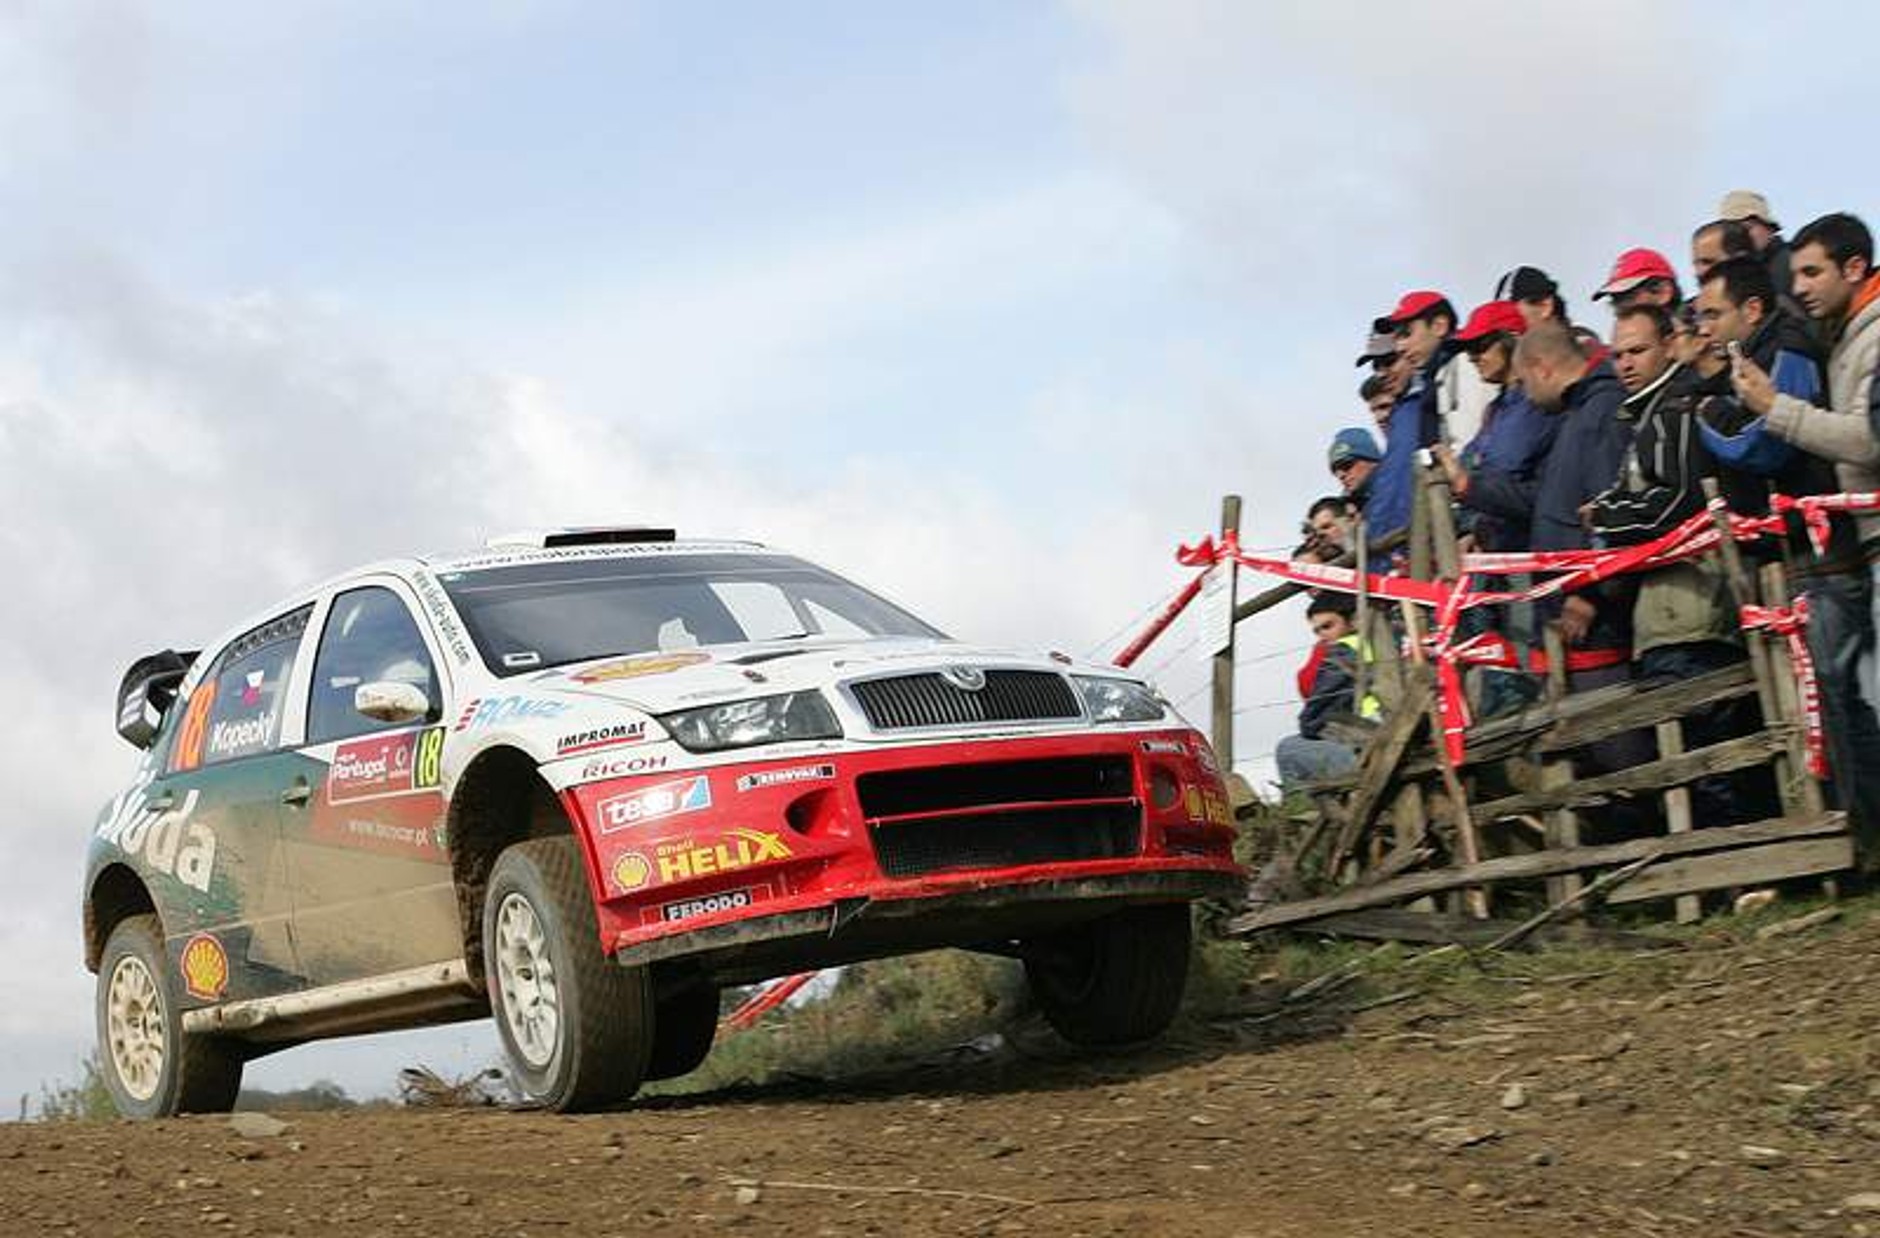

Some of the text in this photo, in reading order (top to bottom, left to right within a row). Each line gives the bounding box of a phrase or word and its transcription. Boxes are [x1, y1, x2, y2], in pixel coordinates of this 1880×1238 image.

[173, 677, 217, 772] 18
[557, 721, 646, 749] IMPROMAT
[419, 727, 442, 786] 18
[583, 755, 668, 779] RICOH
[657, 827, 793, 885] HELIX
[666, 892, 747, 921] FERODO
